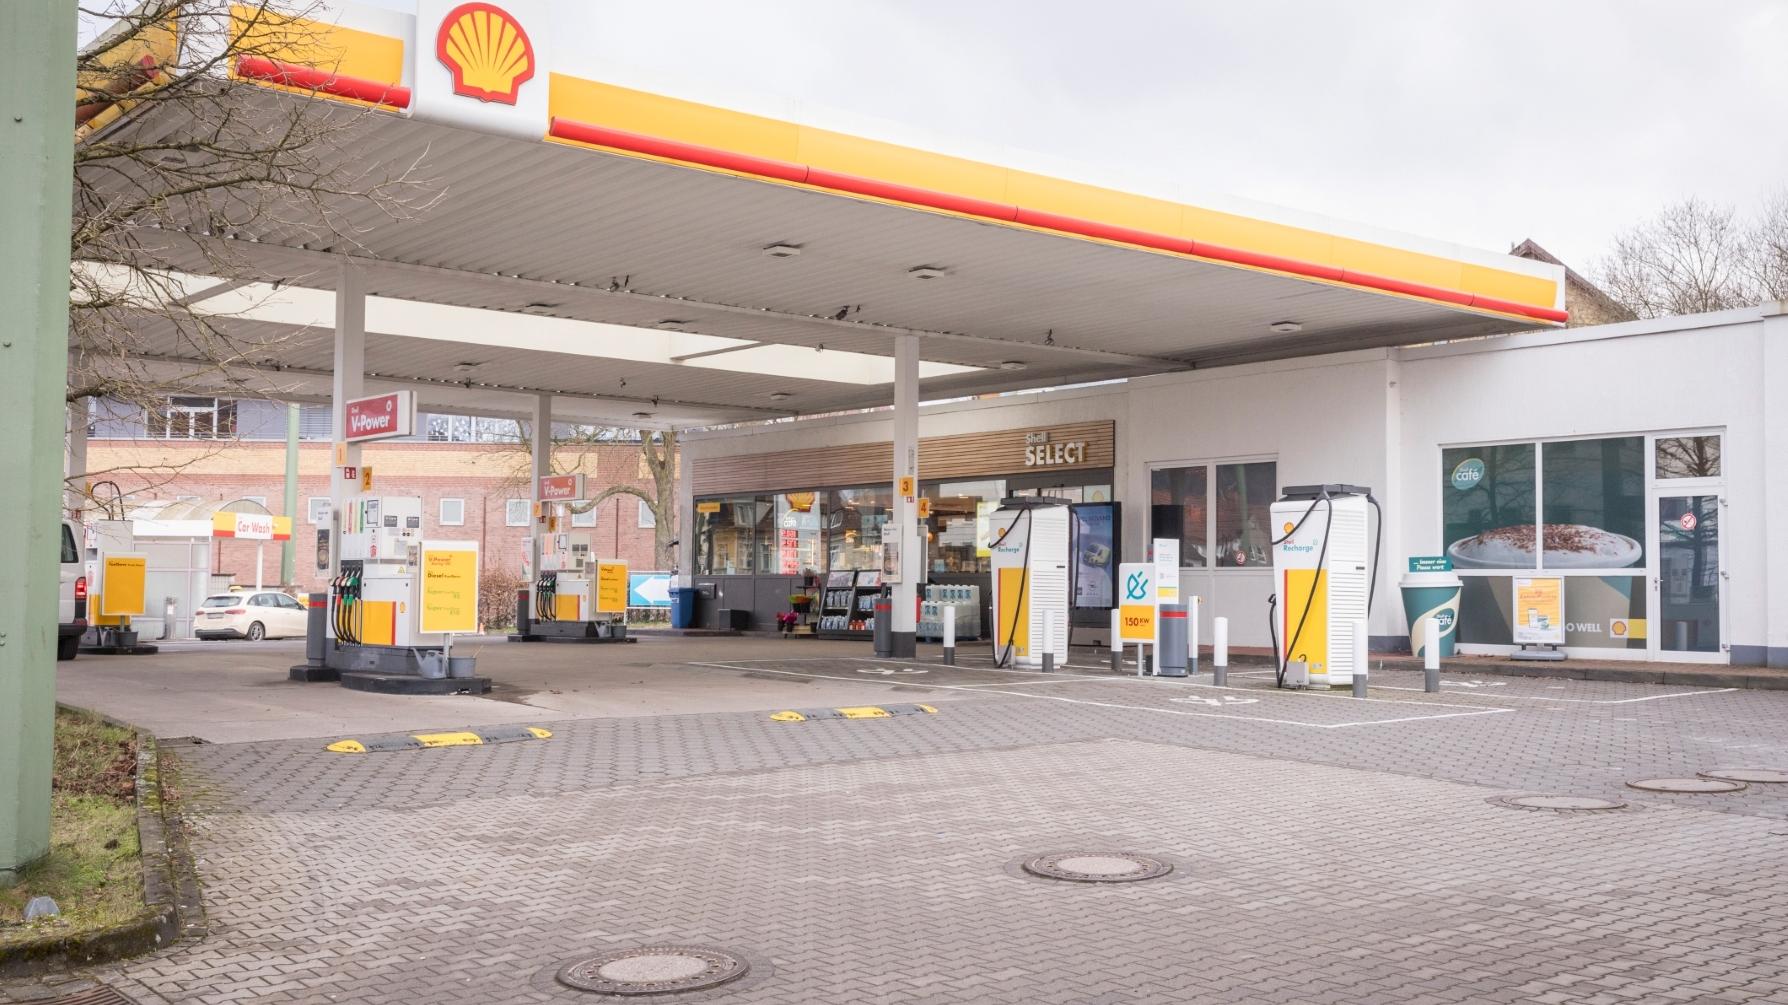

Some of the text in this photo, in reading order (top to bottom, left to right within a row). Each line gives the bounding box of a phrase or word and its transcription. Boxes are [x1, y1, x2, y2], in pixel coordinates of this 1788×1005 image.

[351, 414, 390, 433] V-Power
[1024, 431, 1048, 444] Shell
[1024, 441, 1087, 466] SELECT
[364, 472, 371, 486] 2
[1456, 467, 1480, 481] café
[544, 485, 571, 497] V-Power
[902, 480, 910, 493] 3
[920, 502, 928, 513] 4
[238, 520, 270, 534] Car Wash
[997, 546, 1020, 554] Recharge
[1283, 544, 1314, 553] Recharge
[1124, 617, 1139, 627] 150
[1576, 622, 1602, 632] WELL
